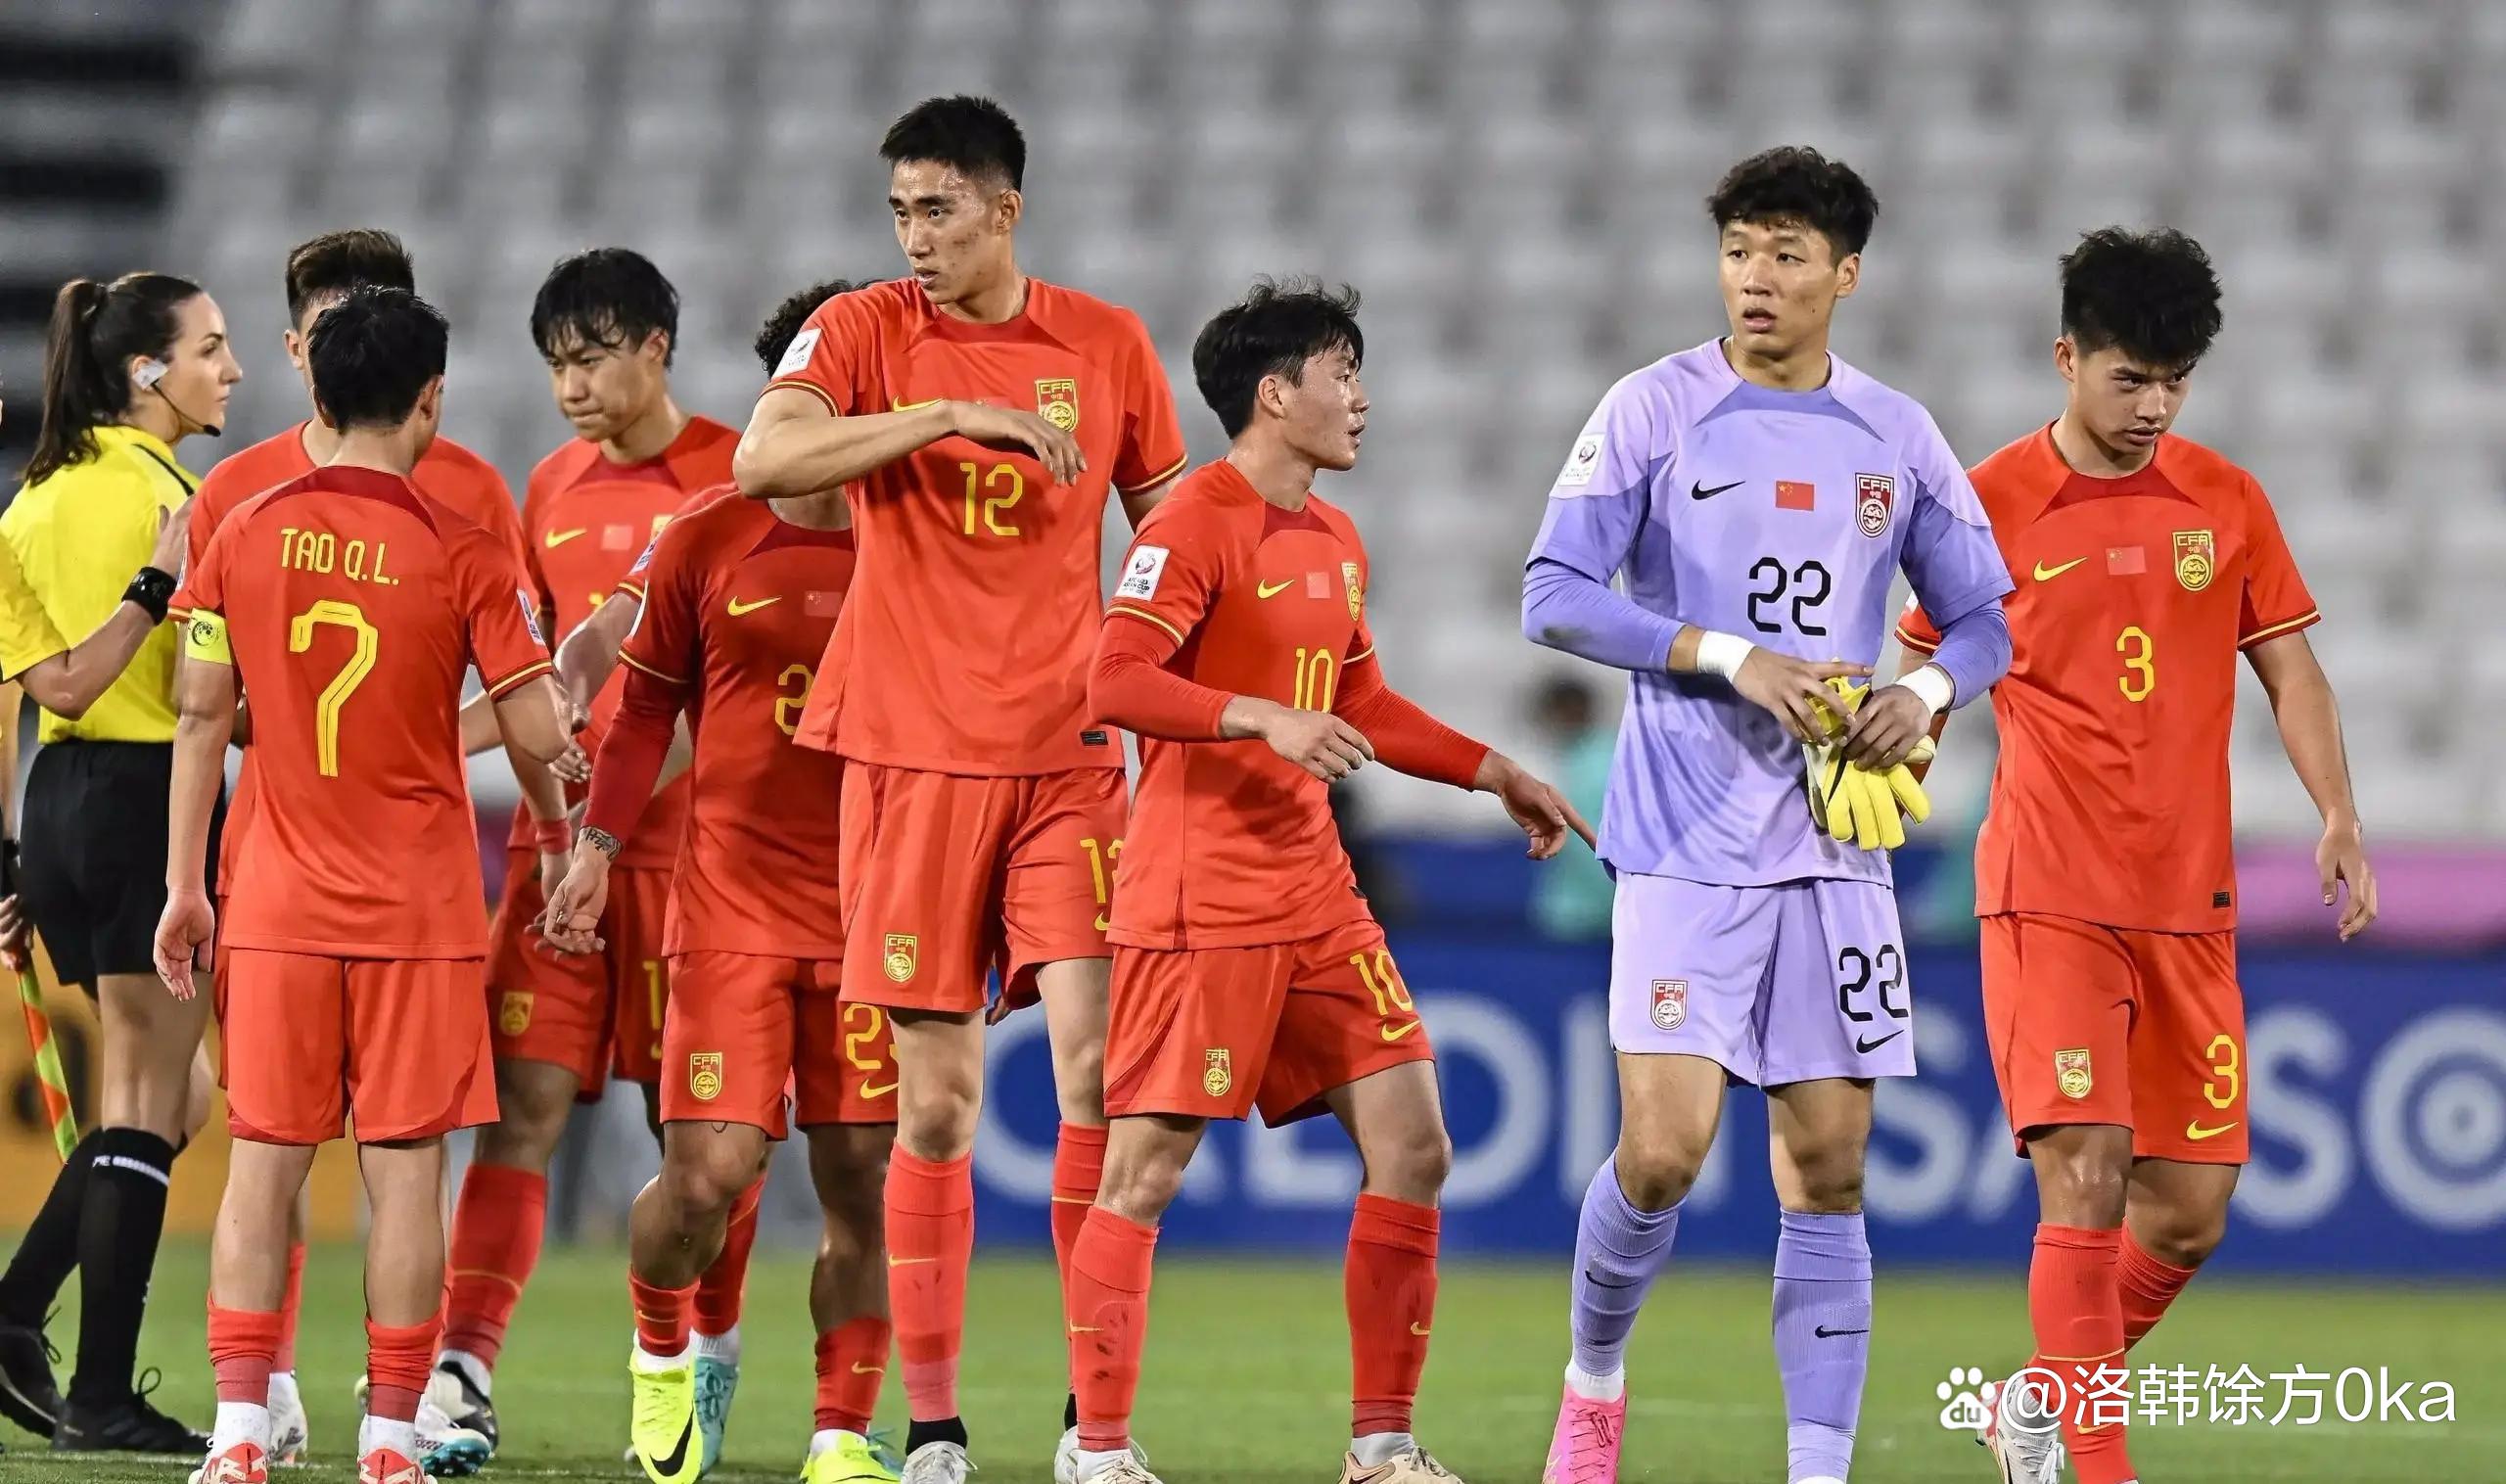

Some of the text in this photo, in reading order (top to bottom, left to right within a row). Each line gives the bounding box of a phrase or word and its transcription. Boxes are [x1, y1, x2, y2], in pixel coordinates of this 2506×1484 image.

[1040, 383, 1073, 394] CFA
[960, 462, 1023, 537] 12
[1860, 478, 1890, 492] CFA
[280, 528, 336, 574] TAO
[2176, 535, 2208, 546] CFA
[1747, 556, 1832, 636] 22
[289, 599, 379, 777] 7
[1293, 647, 1333, 714] 10
[2115, 626, 2156, 703] 3
[889, 937, 914, 948] CFA
[1350, 949, 1414, 1016] 10
[1654, 983, 1685, 994] CFA
[1838, 944, 1909, 1022] 22
[693, 1056, 719, 1066] CFA
[843, 1002, 899, 1070] 2
[2058, 1052, 2087, 1063] CFA
[2203, 1034, 2239, 1109] 3
